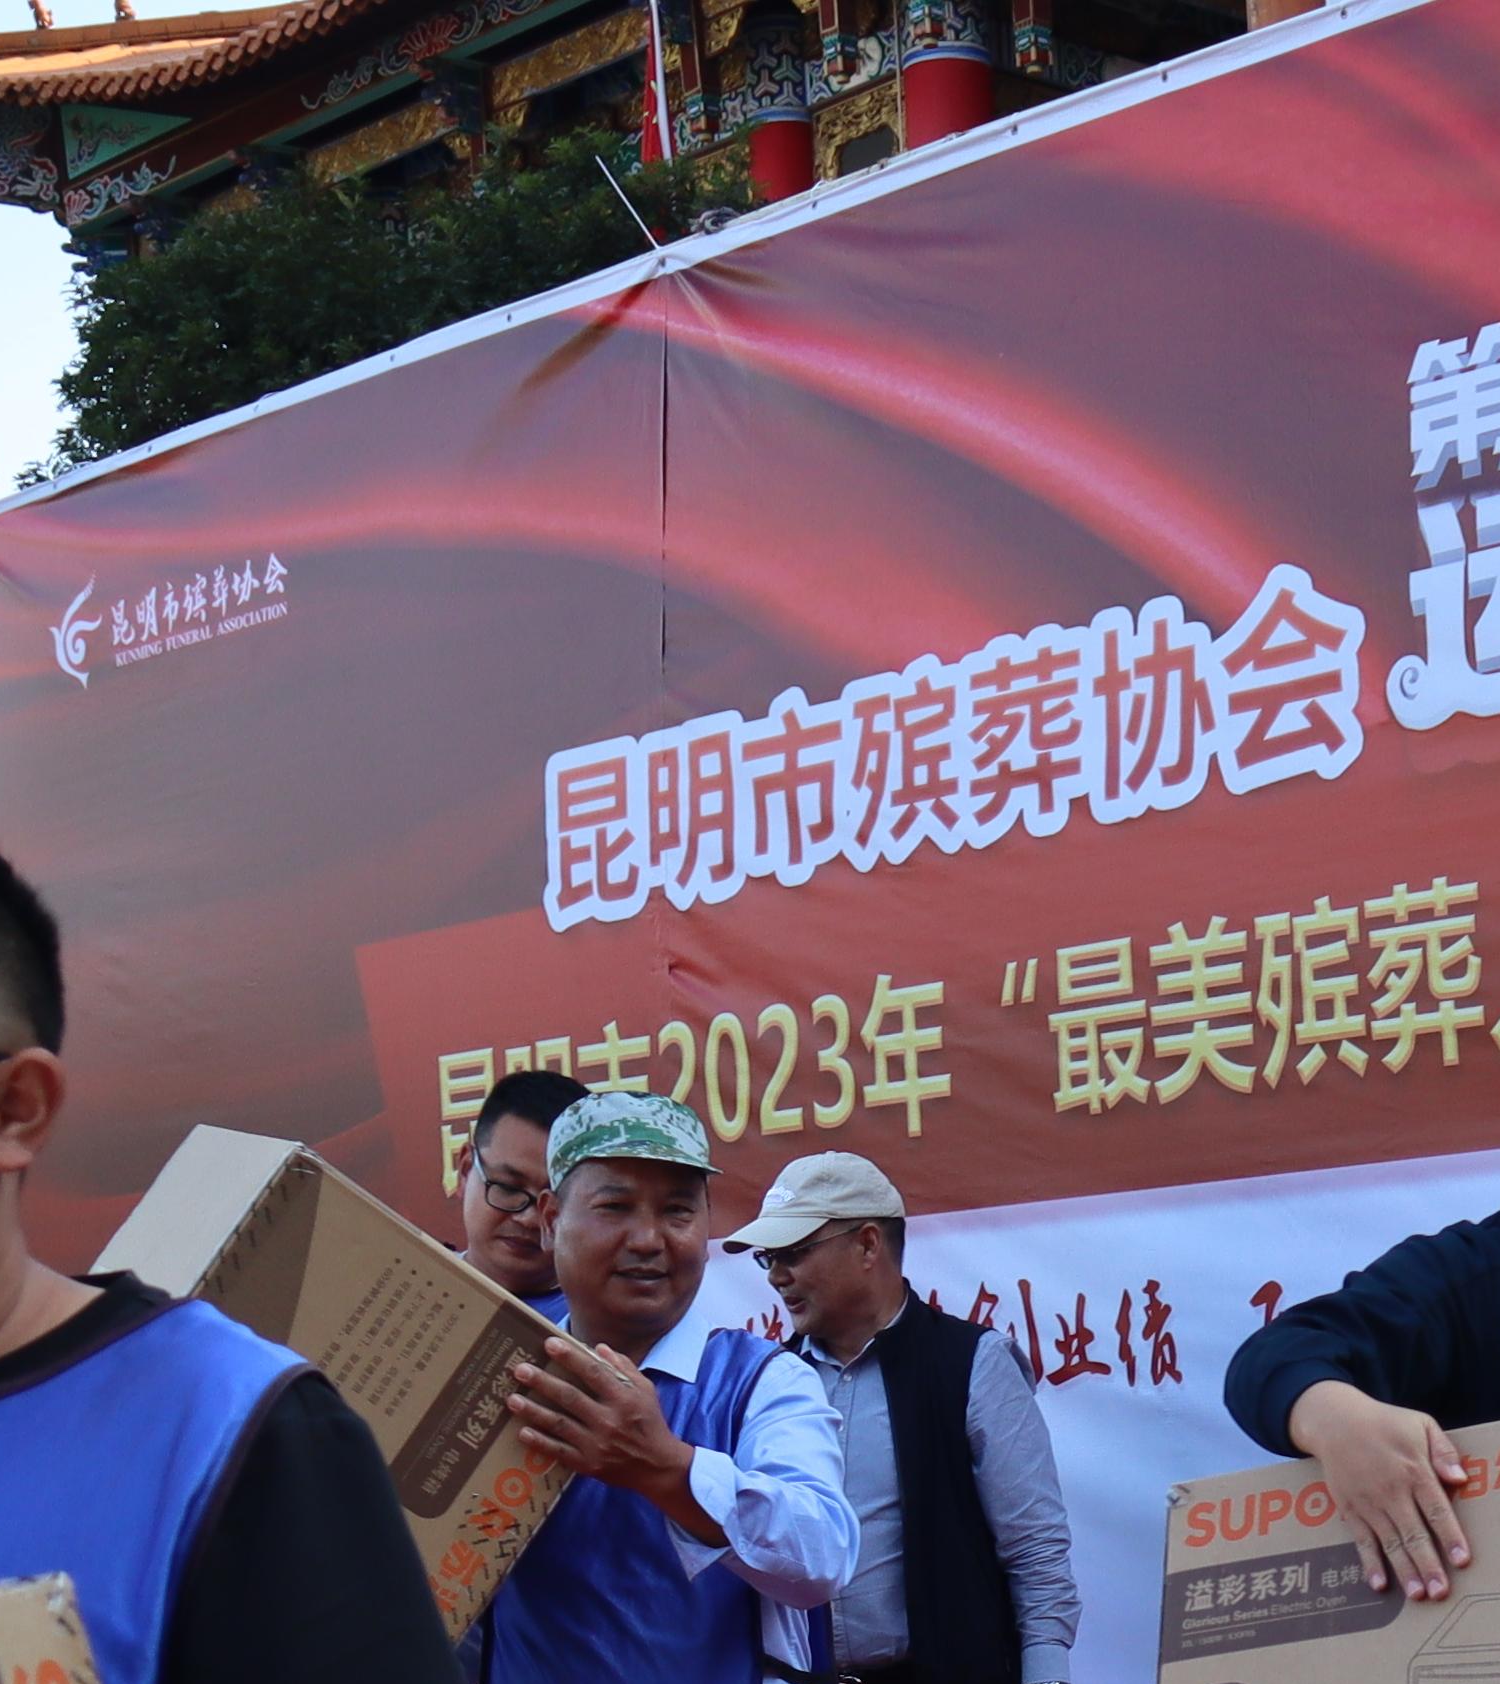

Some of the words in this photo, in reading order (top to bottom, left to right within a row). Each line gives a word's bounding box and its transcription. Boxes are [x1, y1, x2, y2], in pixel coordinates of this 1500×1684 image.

[111, 552, 288, 646] 昆明市殡葬协会
[115, 640, 164, 667] KUNMING
[165, 624, 213, 652] FUNERAL
[216, 600, 289, 636] ASSOCIATION
[546, 572, 1358, 924] 昆明市殡葬协会
[929, 1278, 1184, 1387] 创业绩
[1184, 1481, 1345, 1548] SUPO
[1182, 1612, 1231, 1630] Glorious
[1233, 1606, 1269, 1622] Series
[1270, 1599, 1313, 1616] Electric
[1315, 1595, 1348, 1610] Oven
[1184, 1561, 1311, 1612] 溢彩系列
[1320, 1563, 1369, 1589] 电烤
